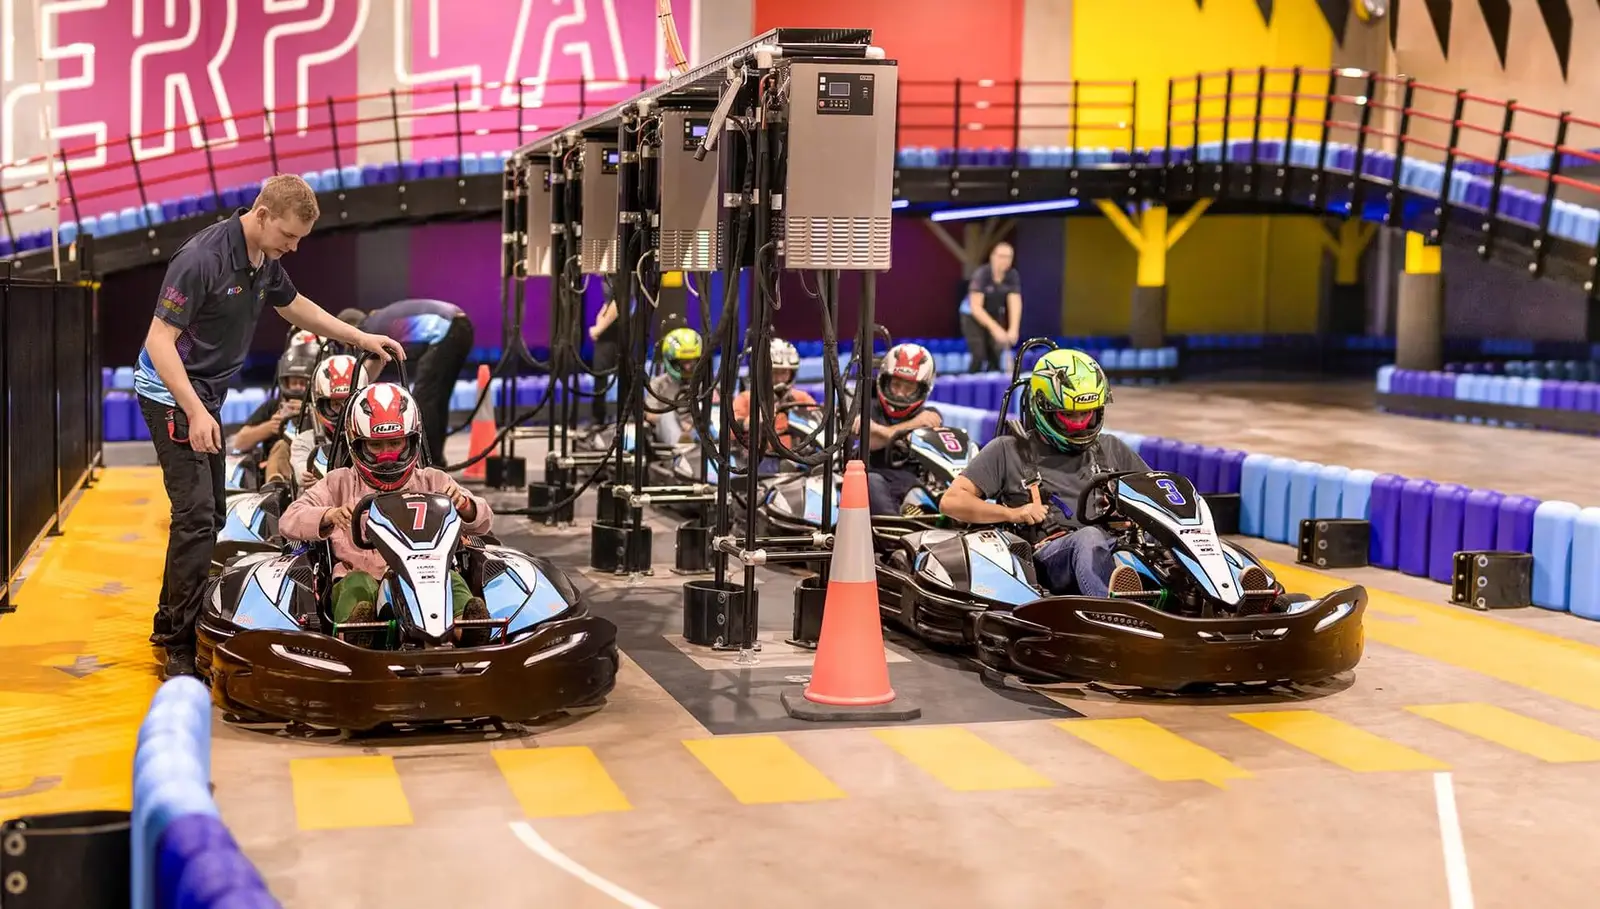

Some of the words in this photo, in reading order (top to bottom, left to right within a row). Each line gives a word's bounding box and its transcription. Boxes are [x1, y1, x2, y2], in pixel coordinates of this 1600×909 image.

[1076, 394, 1098, 403] HJC
[375, 424, 399, 433] HJC
[938, 431, 962, 452] 5
[1155, 478, 1187, 506] 3
[406, 501, 428, 531] 7
